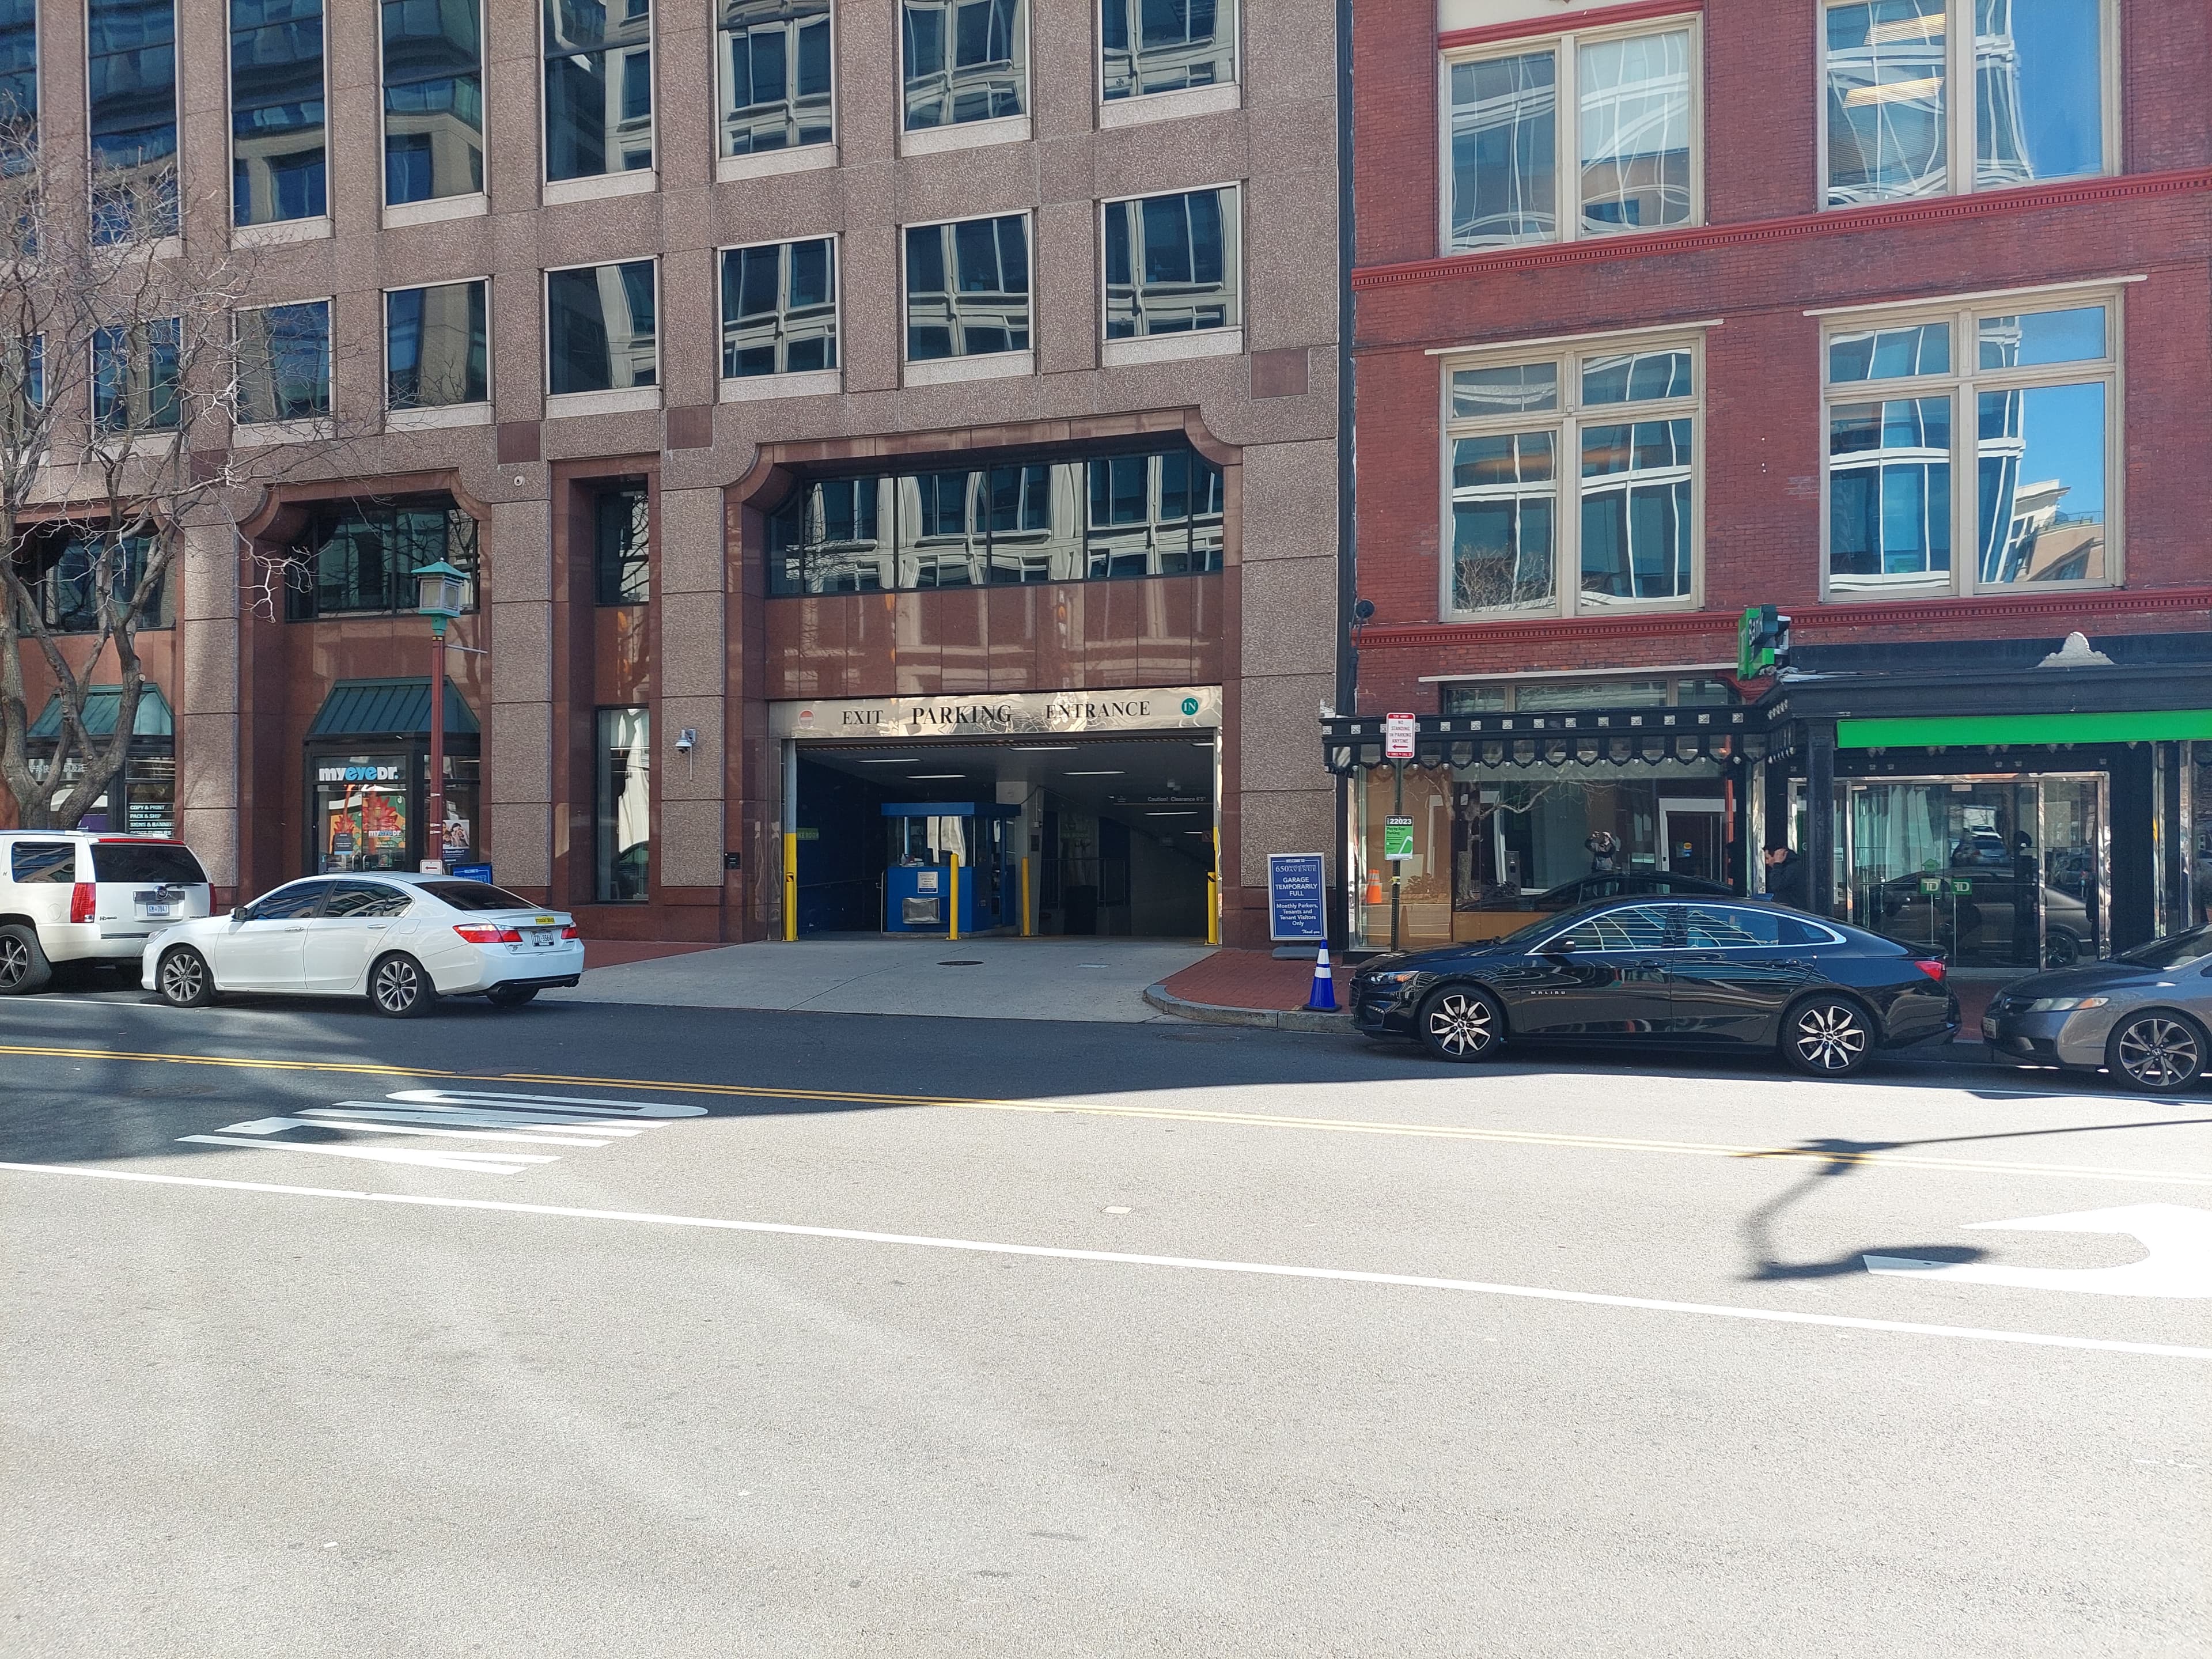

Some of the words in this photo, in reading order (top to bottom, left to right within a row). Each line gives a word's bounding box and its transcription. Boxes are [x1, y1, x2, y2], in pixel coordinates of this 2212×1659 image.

[843, 710, 884, 725] EXIT
[911, 704, 1012, 725] PARKING
[1046, 701, 1150, 719] ENTRANCE
[1184, 702, 1196, 711] IN
[1924, 881, 1939, 891] TD
[1953, 881, 1970, 892] TD
